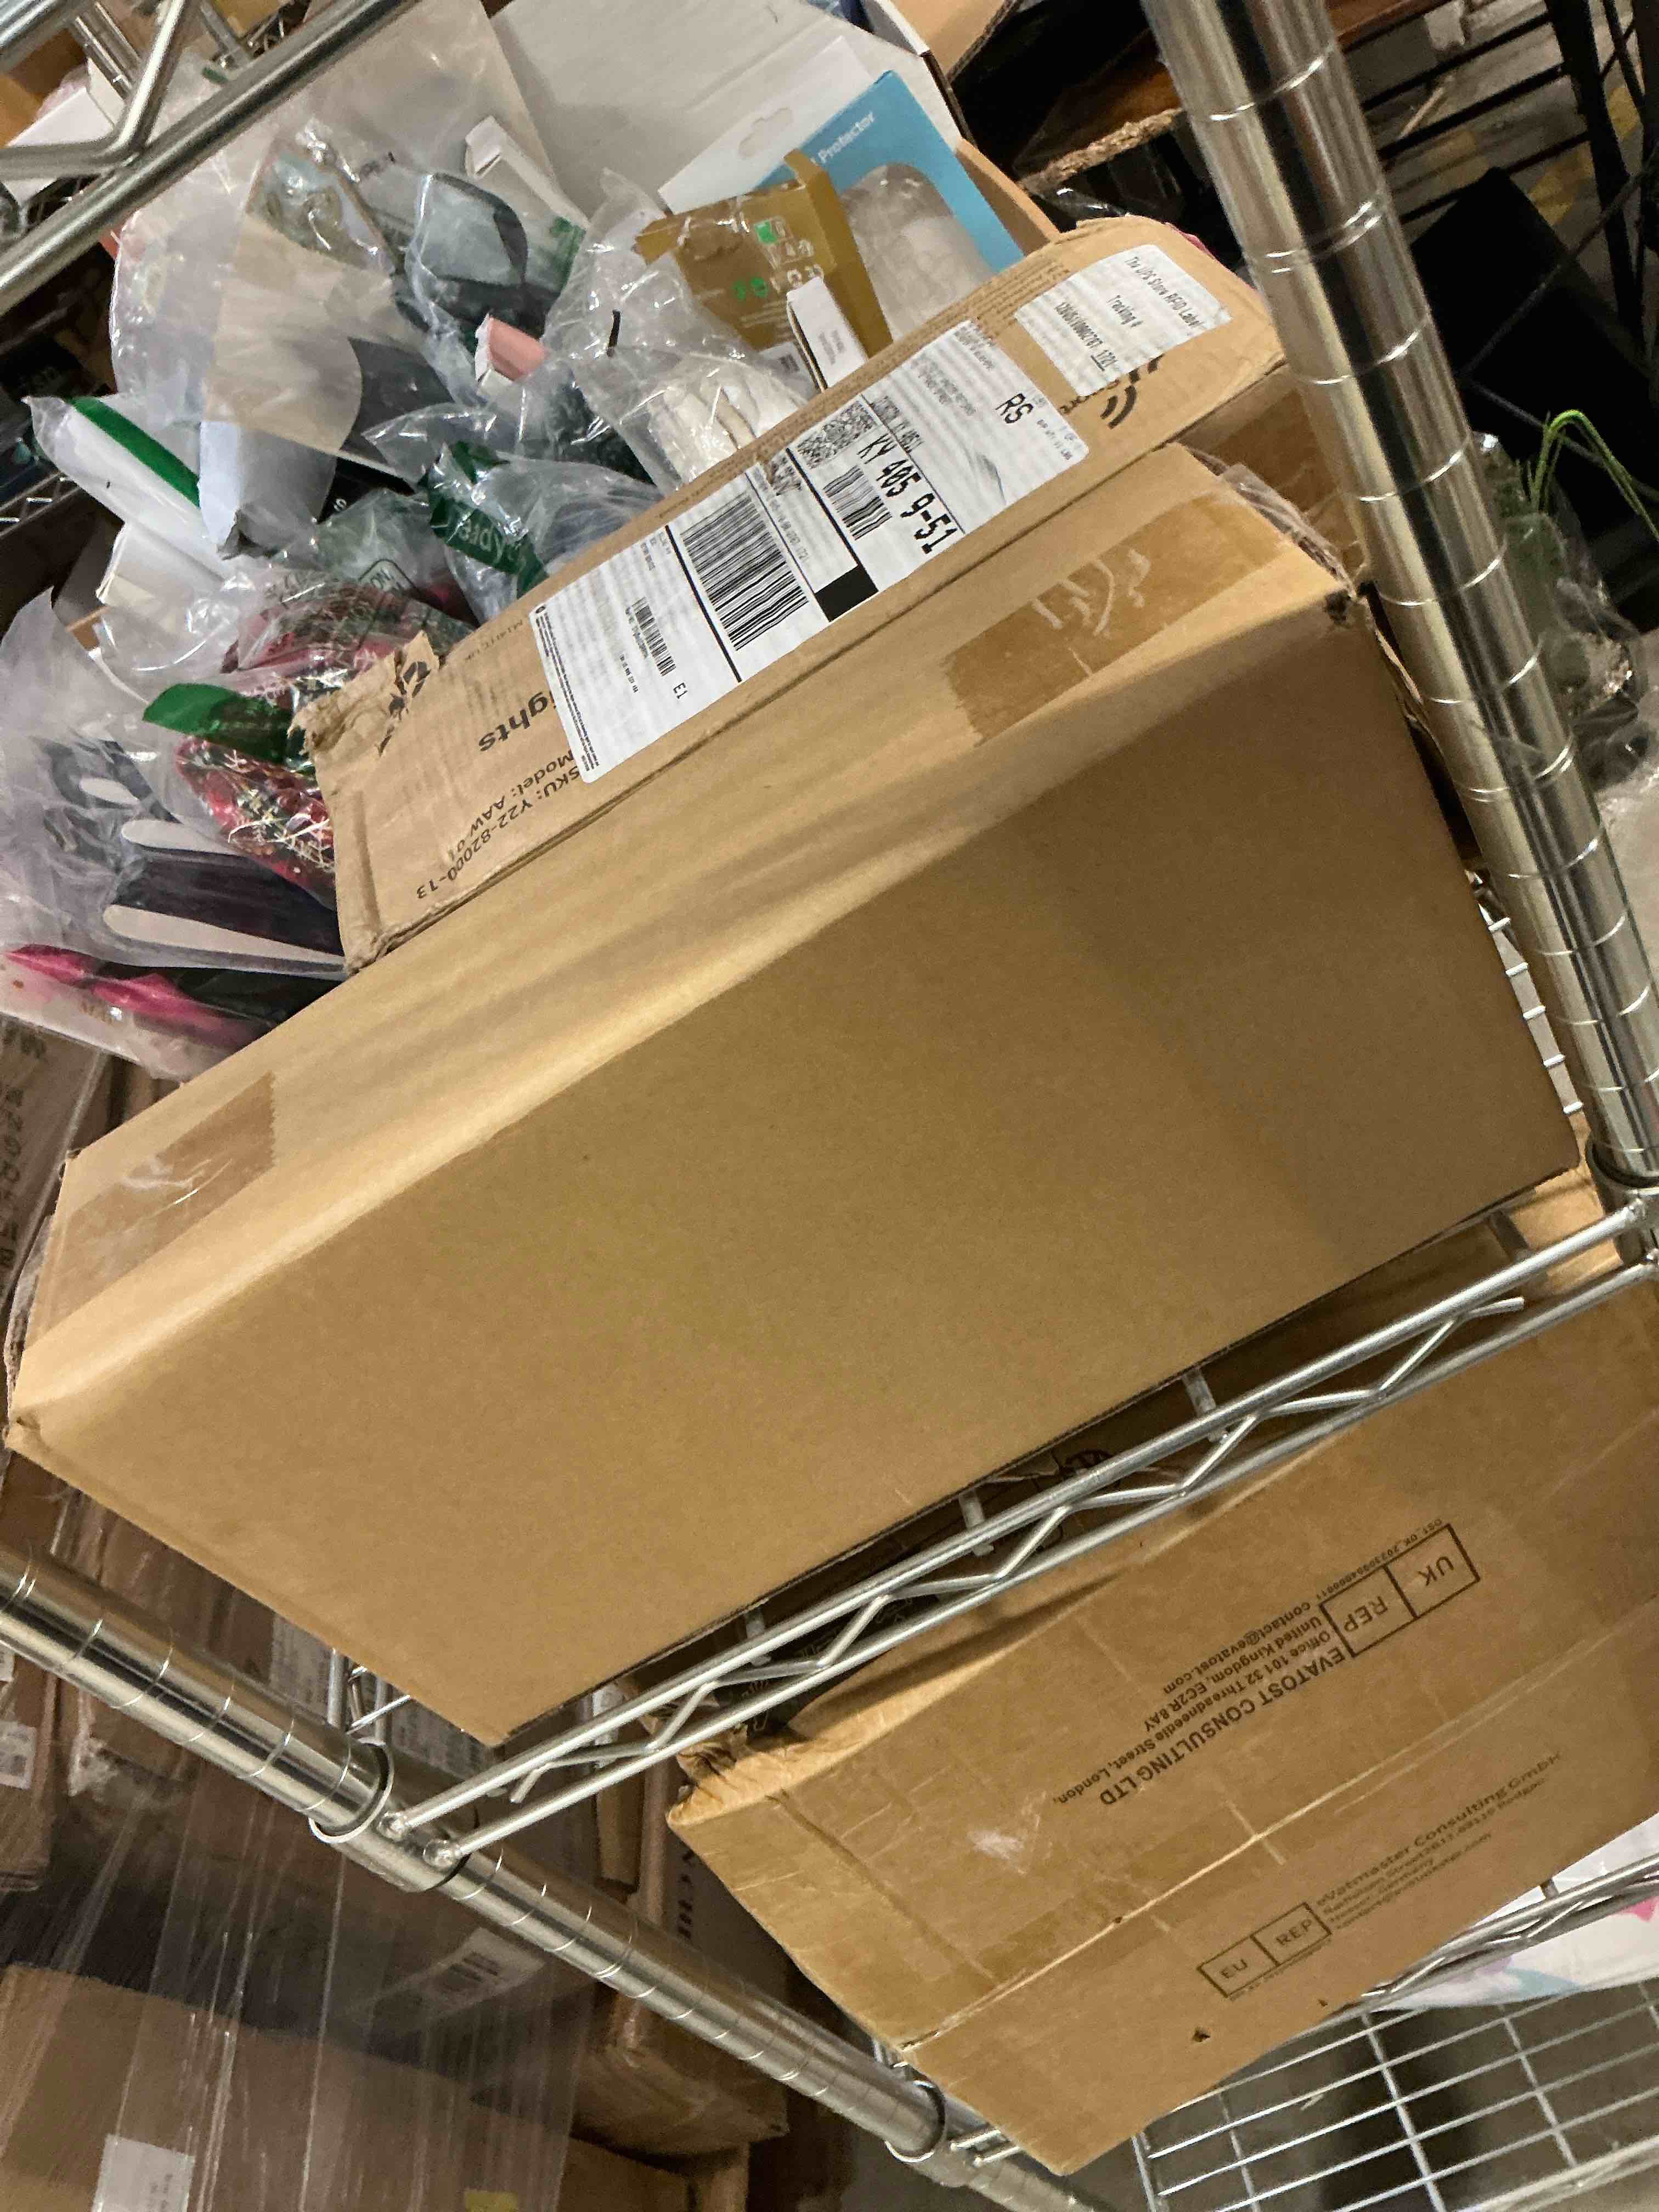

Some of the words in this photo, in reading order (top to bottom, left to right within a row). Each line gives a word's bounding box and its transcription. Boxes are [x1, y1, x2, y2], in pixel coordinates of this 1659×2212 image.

[817, 111, 874, 163] Protector
[995, 393, 1032, 425] RS
[856, 432, 898, 467] KY
[874, 458, 922, 499] 405
[900, 493, 958, 555] 9-51
[673, 682, 688, 699] E1
[511, 749, 574, 796] Model:
[536, 766, 580, 799] SKU:
[417, 799, 533, 899] Y22-82000-13
[1418, 1556, 1454, 1586] UK
[1344, 1596, 1388, 1632] REP
[1275, 1616, 1322, 1649] United
[1289, 1630, 1331, 1657] Office
[1206, 1643, 1276, 1684] Kingdom,
[1245, 1670, 1264, 1686] 32
[1259, 1646, 1346, 1707] EVATOST
[1263, 1655, 1289, 1675] 101
[1171, 1680, 1208, 1712] EC2R
[1107, 1739, 1156, 1770] Street,
[1136, 1698, 1256, 1782] CONSULTING
[1053, 1768, 1111, 1804] London,
[1100, 1775, 1138, 1805] LTD
[1414, 1786, 1508, 1847] Consulting
[1276, 1918, 1312, 1946] REP
[1220, 1959, 1248, 1979] EU
